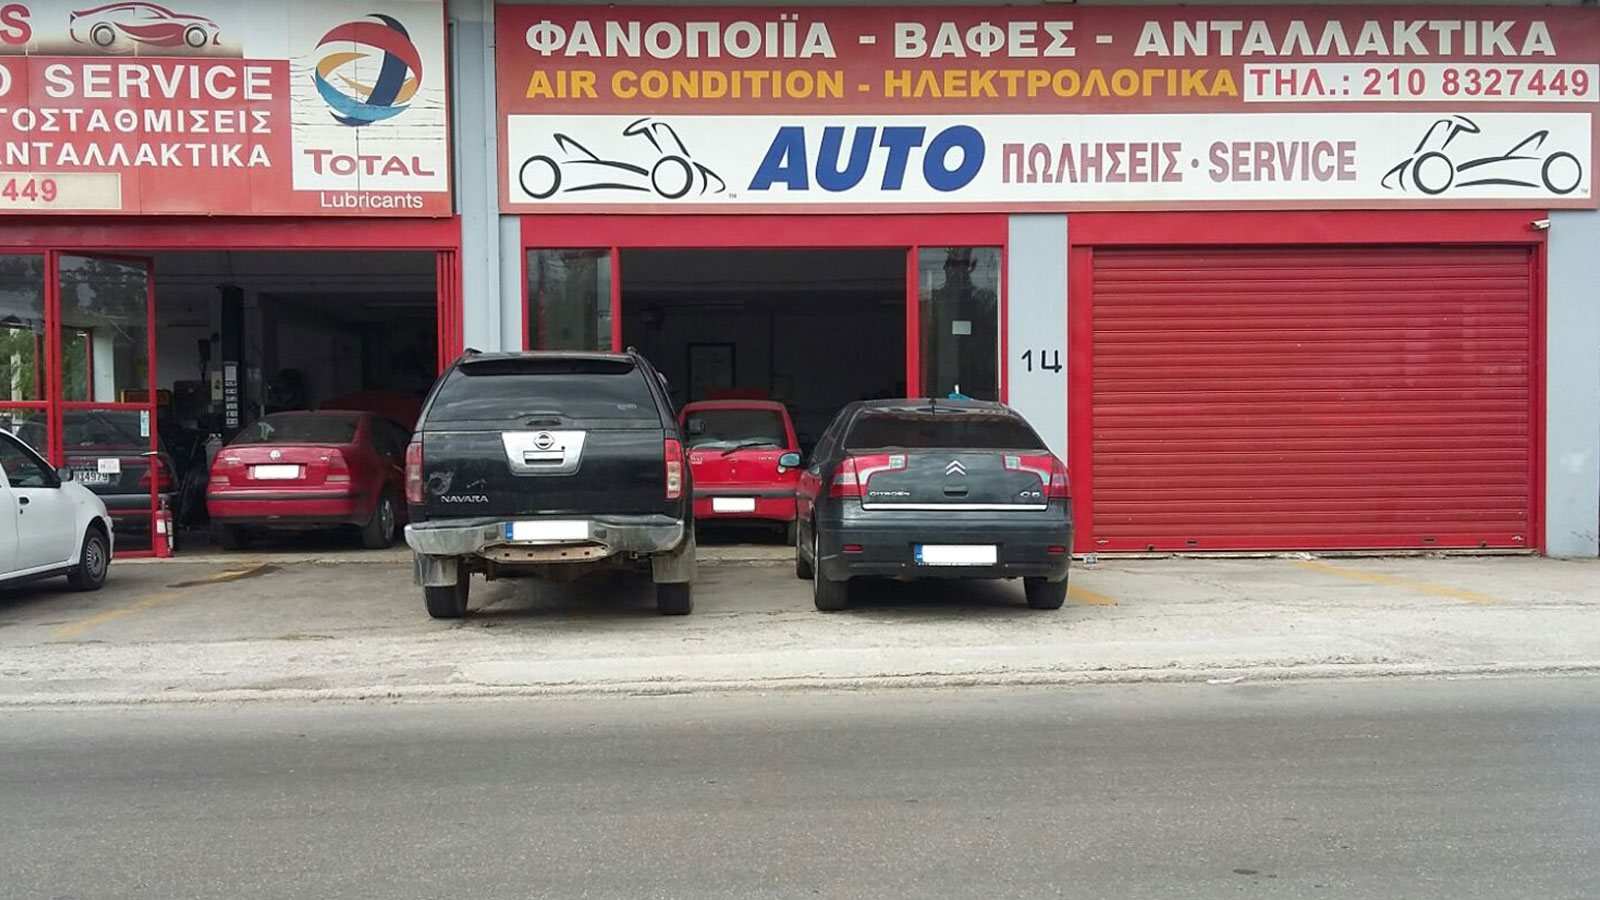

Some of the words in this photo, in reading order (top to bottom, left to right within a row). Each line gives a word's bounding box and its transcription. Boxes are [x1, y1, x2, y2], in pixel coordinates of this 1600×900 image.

[894, 21, 1076, 59] ΒΑΦΕΣ
[1133, 20, 1557, 57] ΑΝΤΑΛΛΑΚΤΙΚΑ
[44, 63, 273, 101] SERVICE
[525, 69, 600, 99] AIR
[611, 69, 845, 99] CONDITION
[884, 68, 1238, 98] ΗΛΕΚΤΡΟΛΟΓΙΚΑ
[1363, 67, 1427, 97] 210
[1441, 67, 1590, 97] 8327449
[0, 142, 272, 167] ΝΤΑΛΛΑΚΤΙΚΑ
[303, 149, 435, 176] TOTAL
[748, 125, 985, 192] AUTO
[1002, 142, 1183, 183] ΠΩΛΗΣΕΙΣ
[1208, 141, 1357, 182] SERVICE
[320, 191, 424, 208] Lubricants
[1021, 349, 1063, 374] 14
[440, 494, 489, 503] NAVARA
